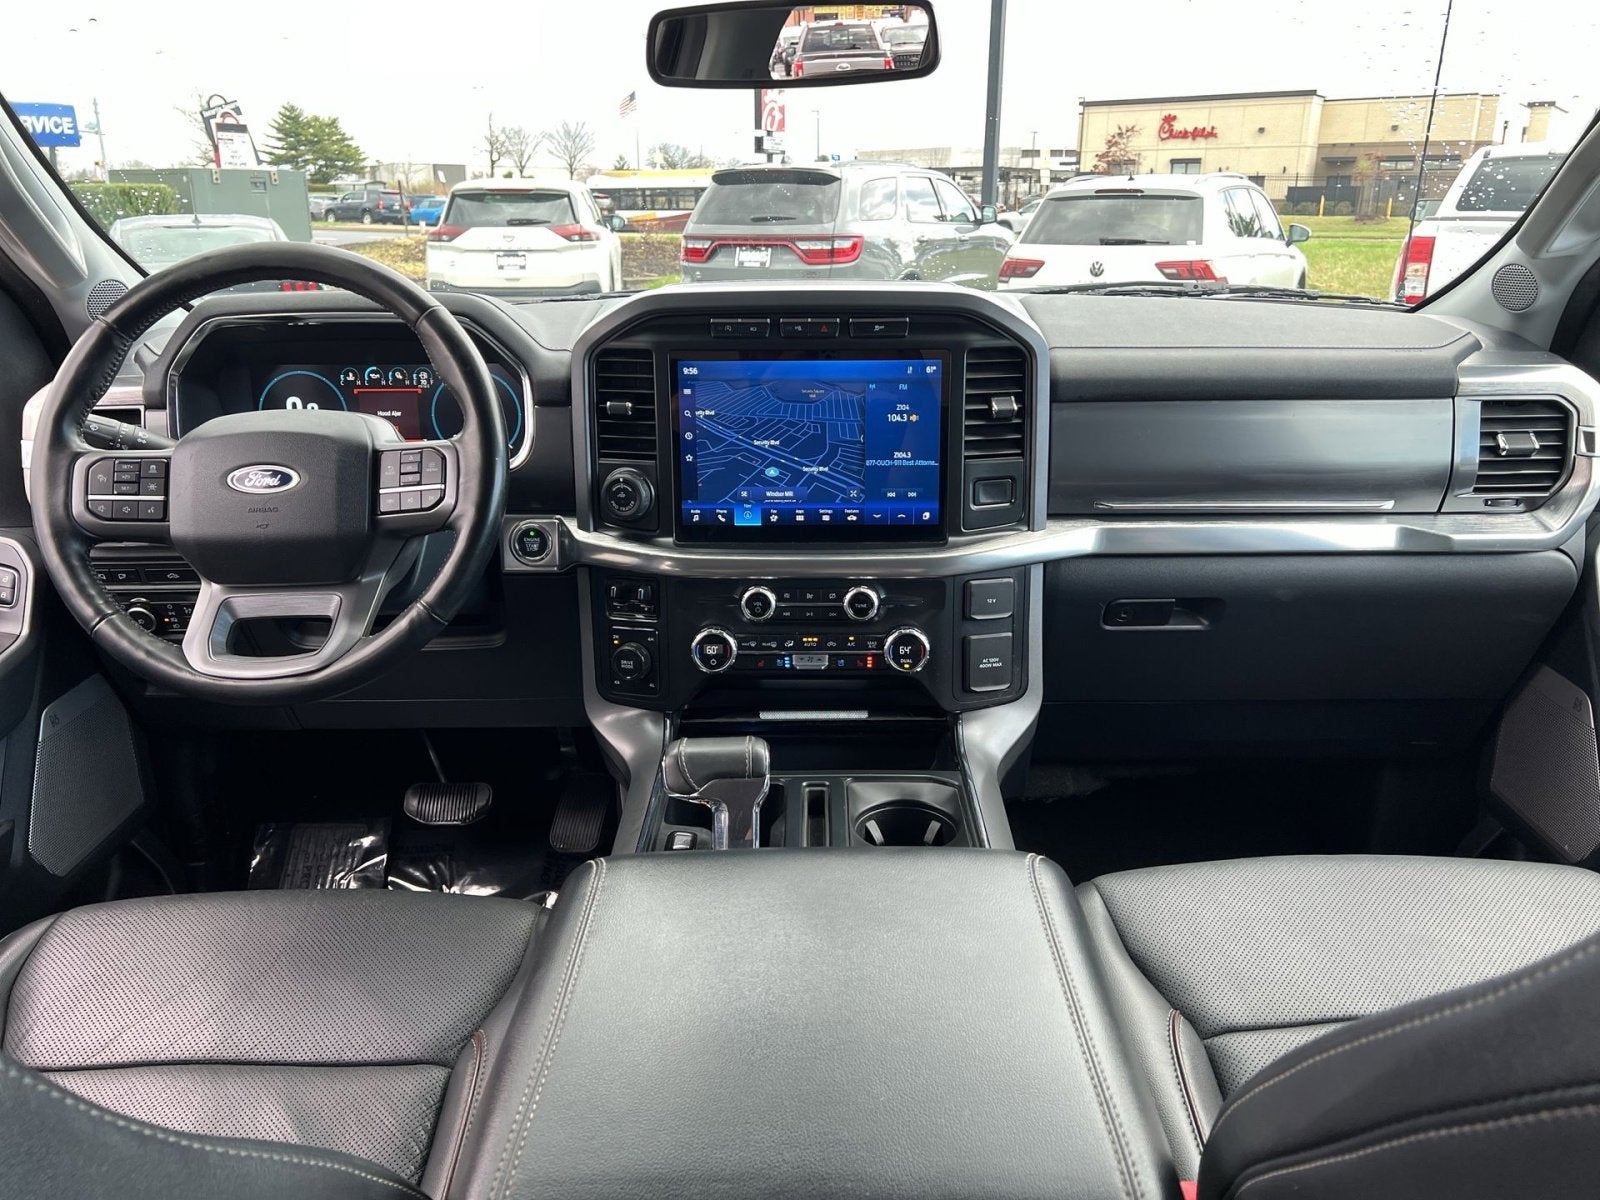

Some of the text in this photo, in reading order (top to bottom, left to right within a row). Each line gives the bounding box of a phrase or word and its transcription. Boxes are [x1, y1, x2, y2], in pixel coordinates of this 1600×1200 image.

[19, 115, 75, 135] RVICE
[682, 367, 698, 375] 9:56
[392, 410, 402, 418] Ajar
[887, 413, 908, 422] 104.3
[244, 470, 281, 487] Ford
